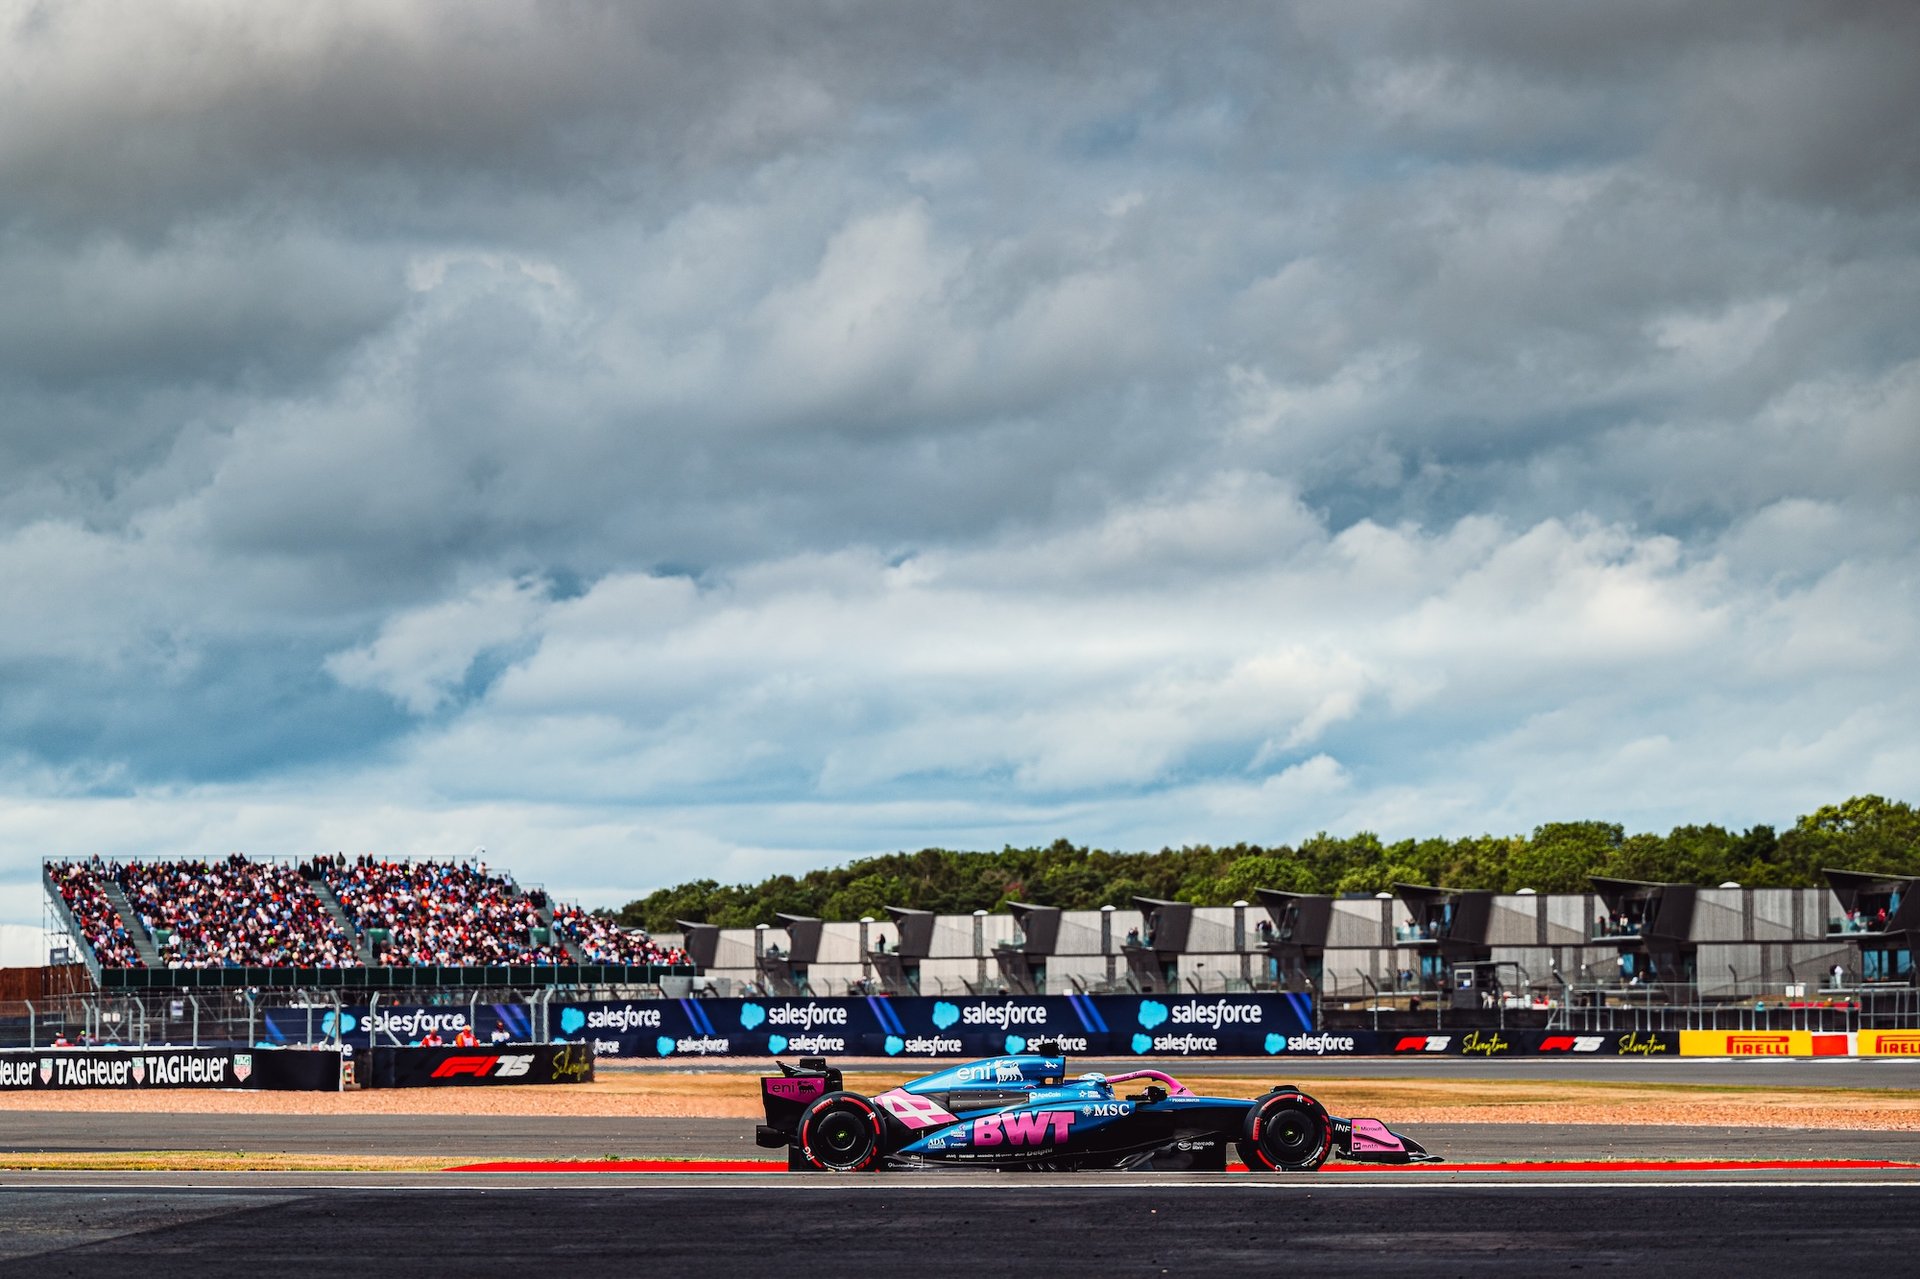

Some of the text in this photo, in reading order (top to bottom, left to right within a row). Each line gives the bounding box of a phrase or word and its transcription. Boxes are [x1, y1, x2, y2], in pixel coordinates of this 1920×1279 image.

[361, 1009, 466, 1036] salesforce
[588, 1005, 661, 1032] salesforce
[769, 1002, 847, 1030] salesforce
[963, 1001, 1047, 1030] salesforce
[1172, 999, 1262, 1029] salesforce
[676, 1035, 729, 1053] salesforce
[788, 1034, 844, 1054] salesforce
[905, 1035, 962, 1056] salesforce
[1154, 1033, 1217, 1055] salesforce
[1288, 1033, 1354, 1055] salesforce
[1726, 1036, 1789, 1054] PIRELLI
[1875, 1035, 1920, 1053] PIREL
[957, 1061, 990, 1080] eni
[772, 1082, 795, 1093] eni
[1094, 1103, 1130, 1117] MSC
[974, 1111, 1075, 1146] BWT
[928, 1138, 946, 1146] ADA
